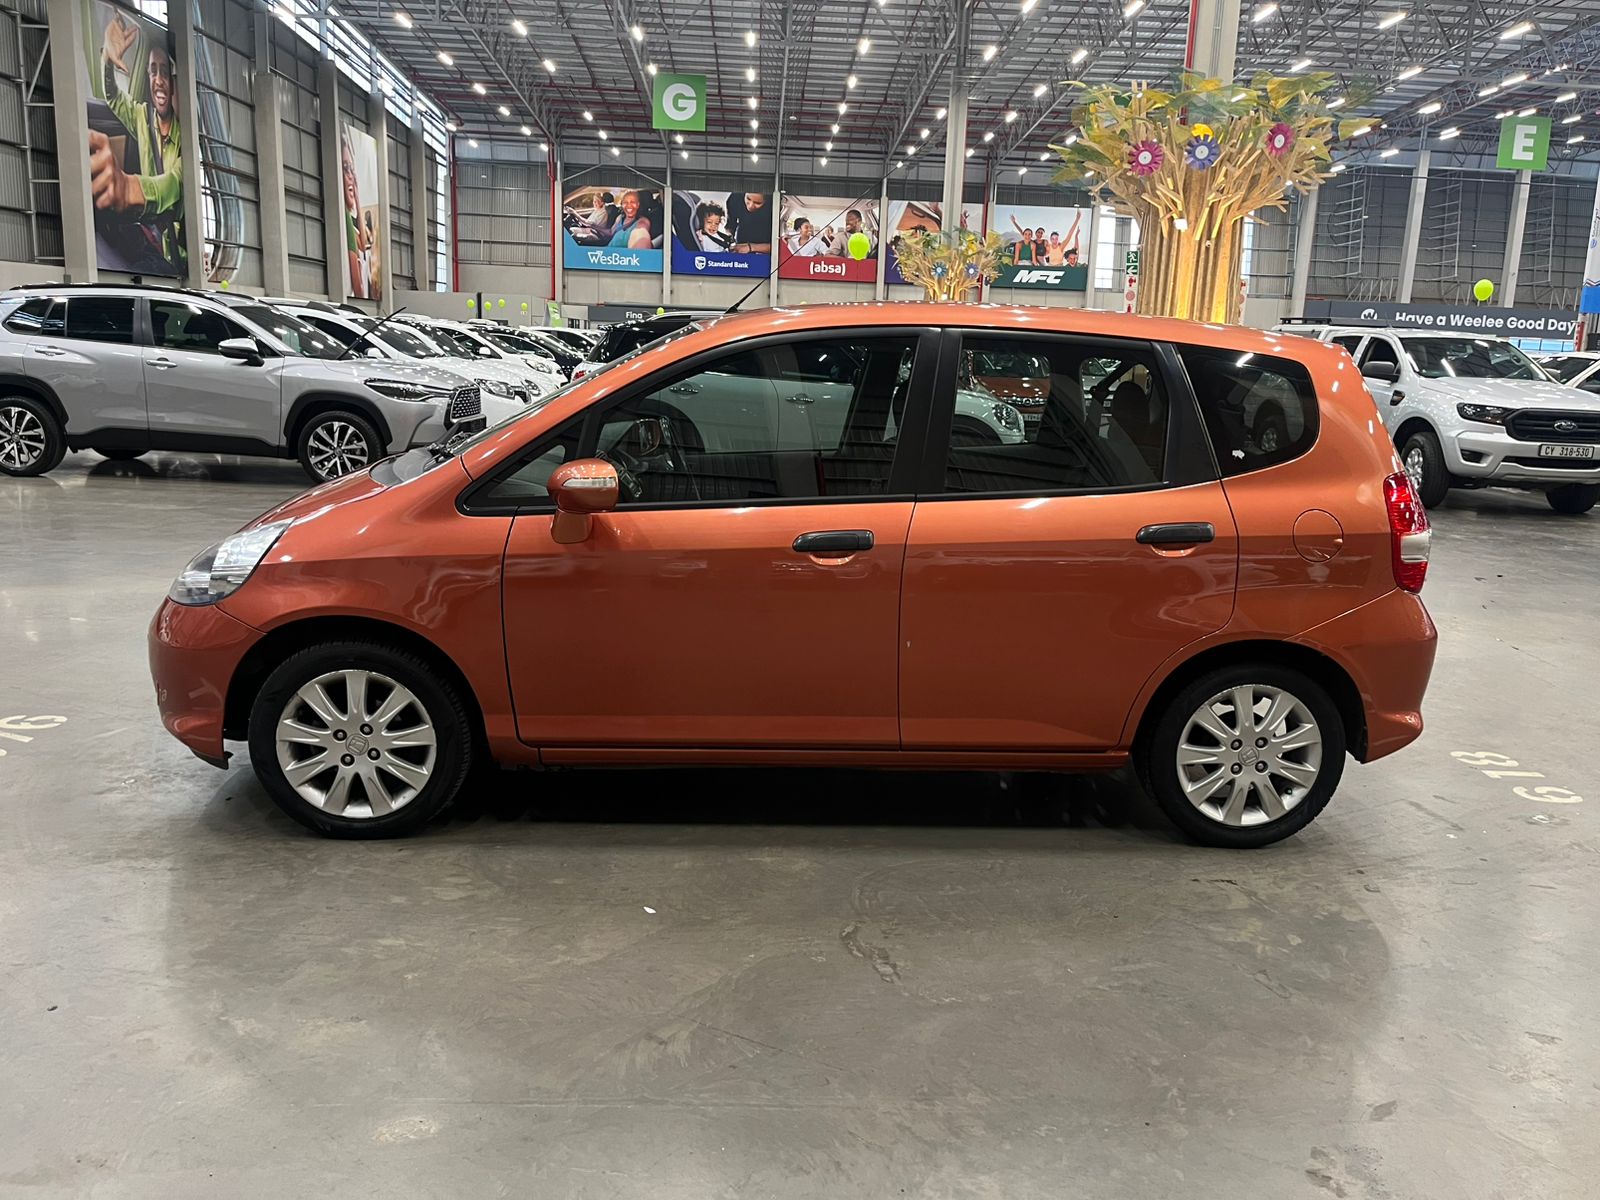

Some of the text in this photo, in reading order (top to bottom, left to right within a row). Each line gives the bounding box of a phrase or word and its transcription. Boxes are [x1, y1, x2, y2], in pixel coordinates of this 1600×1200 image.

[662, 83, 697, 121] G
[1512, 124, 1537, 160] E
[588, 250, 640, 266] WesBank
[707, 260, 749, 269] Standard Bank
[1012, 269, 1066, 284] MFC
[1395, 312, 1433, 325] Have
[1436, 315, 1447, 326] a
[1450, 314, 1504, 329] Weelee
[1506, 316, 1545, 330] Good
[1547, 319, 1577, 335] Day
